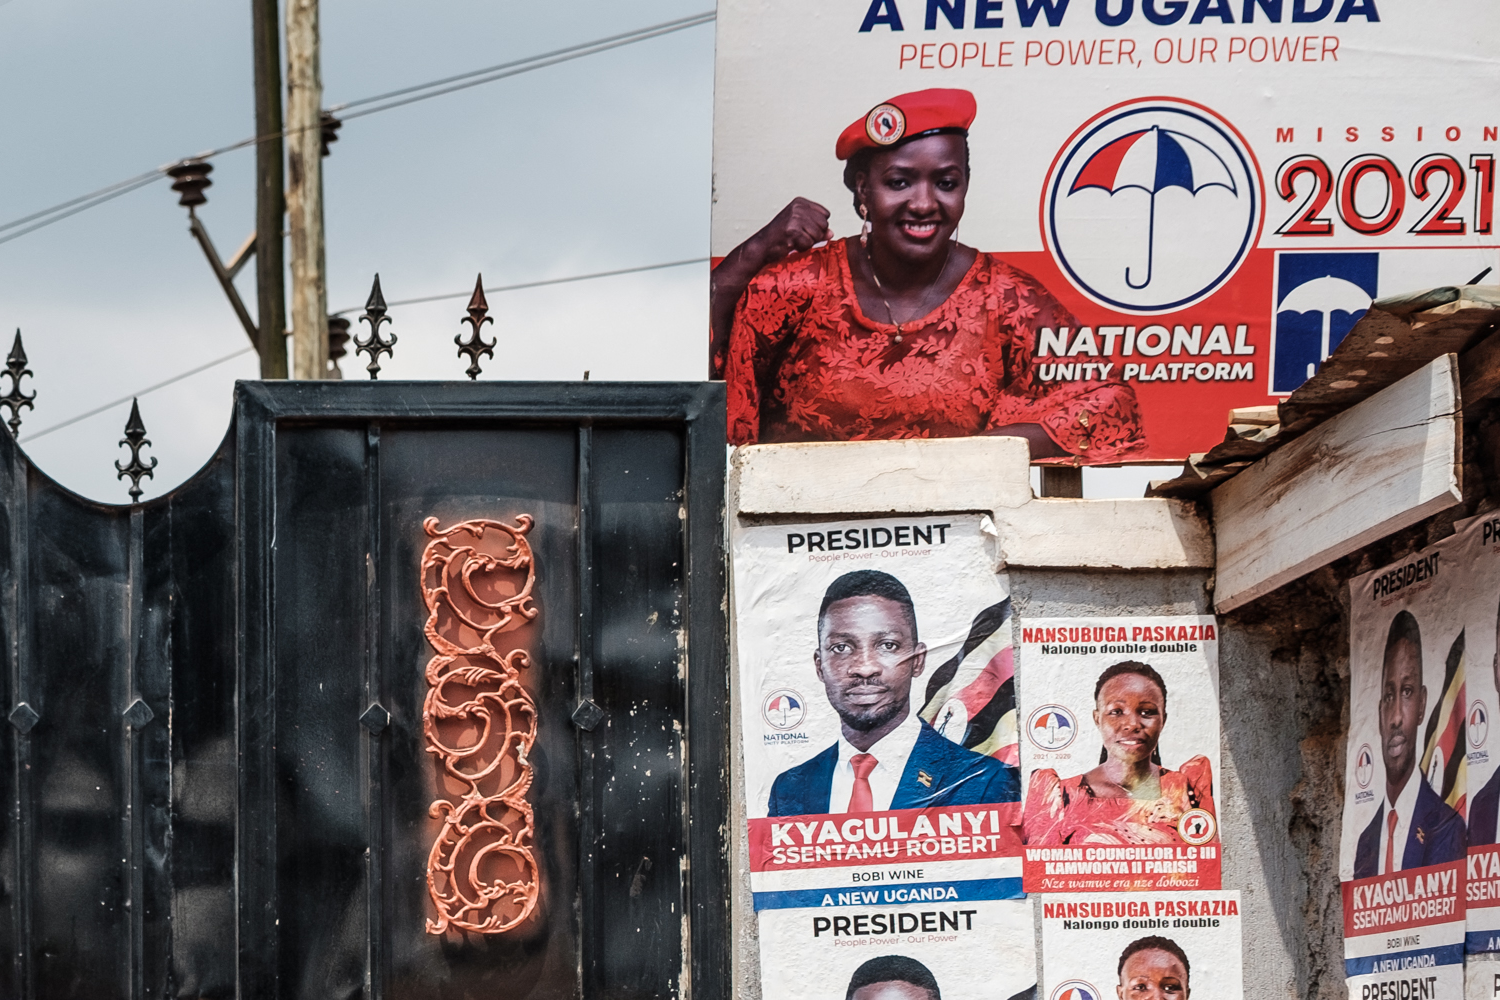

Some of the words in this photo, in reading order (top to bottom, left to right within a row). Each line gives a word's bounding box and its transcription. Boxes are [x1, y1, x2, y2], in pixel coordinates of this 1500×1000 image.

[858, 0, 905, 32] A
[923, 0, 1071, 30] NEW
[1095, 0, 1383, 27] UGANDA
[899, 40, 1016, 70] PEOPLE
[1024, 38, 1144, 70] POWER,
[1153, 36, 1218, 64] OUR
[1227, 35, 1341, 63] POWER
[1276, 126, 1498, 143] MISSION
[1273, 153, 1497, 237] 2021
[1037, 324, 1255, 357] NATIONAL
[1038, 362, 1114, 381] UNITY
[1123, 361, 1254, 381] PLATFORM
[787, 523, 951, 553] PRESIDENT
[808, 553, 841, 563] People
[843, 551, 873, 561] Power
[881, 549, 899, 558] Our
[902, 548, 932, 557] Power
[1373, 552, 1439, 600] PRESIDENT
[1023, 627, 1127, 643] NANSUBUGA
[1133, 625, 1216, 642] PASKAZIA
[1041, 644, 1097, 655] Nalongo
[1100, 643, 1147, 654] double
[1151, 642, 1197, 653] double
[764, 733, 809, 741] NATIONAL
[771, 810, 1000, 847] KYAGULANYI
[772, 842, 899, 865] SSENTAMU
[906, 834, 1001, 857] ROBERT
[1026, 848, 1083, 861] WOMAN
[1086, 847, 1174, 861] COUNCILLOR
[1176, 847, 1197, 860] L.C
[1200, 846, 1216, 859] III
[852, 872, 885, 883] BOBI
[888, 869, 924, 881] WINE
[1045, 862, 1128, 875] KAMWOKYA
[1131, 861, 1142, 874] II
[1145, 860, 1197, 874] PARISH
[1040, 878, 1065, 890] Nze
[1068, 880, 1111, 889] wamwe
[1113, 880, 1131, 889] era
[1134, 879, 1154, 888] nze
[1156, 876, 1200, 888] doboozi
[1353, 869, 1457, 910] KYAGULANYI
[821, 894, 835, 907] A
[838, 892, 879, 905] NEW
[884, 886, 958, 903] UGANDA
[1043, 902, 1150, 919] NANSUBUGA
[1155, 900, 1238, 917] PASKAZIA
[1353, 905, 1410, 930] SSENTAMU
[1412, 897, 1457, 920] ROBERT
[813, 909, 977, 938] PRESIDENT
[1063, 920, 1119, 930] Nalongo
[1123, 918, 1169, 929] double
[1173, 917, 1220, 928] double
[834, 938, 867, 948] People
[869, 936, 900, 946] Power
[908, 935, 925, 944] Our
[927, 933, 958, 943] Power
[1387, 937, 1402, 949] BOBI
[1403, 935, 1420, 947] WINE
[1372, 962, 1380, 974] A
[1380, 958, 1399, 972] NEW
[1401, 954, 1436, 970] UGANDA
